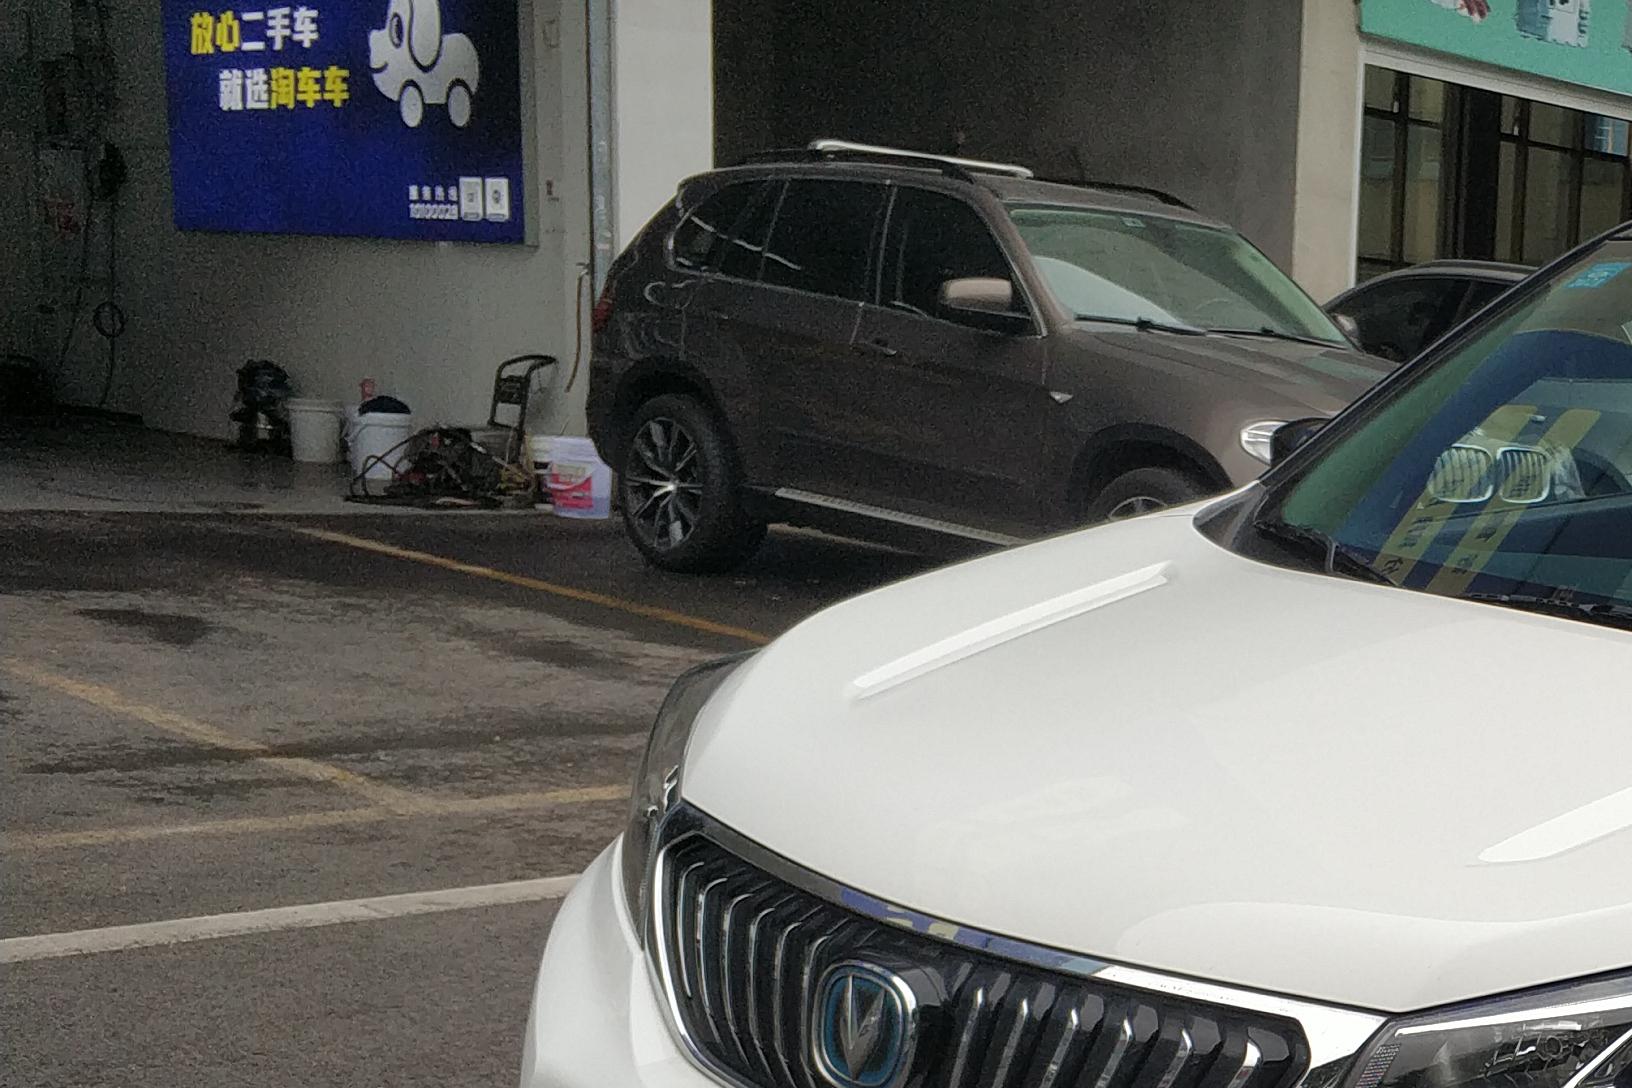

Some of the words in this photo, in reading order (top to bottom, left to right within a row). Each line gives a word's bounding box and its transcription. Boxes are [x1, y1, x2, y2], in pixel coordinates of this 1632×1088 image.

[191, 6, 319, 55] 放心二手车
[219, 65, 350, 111] 就选淘车车
